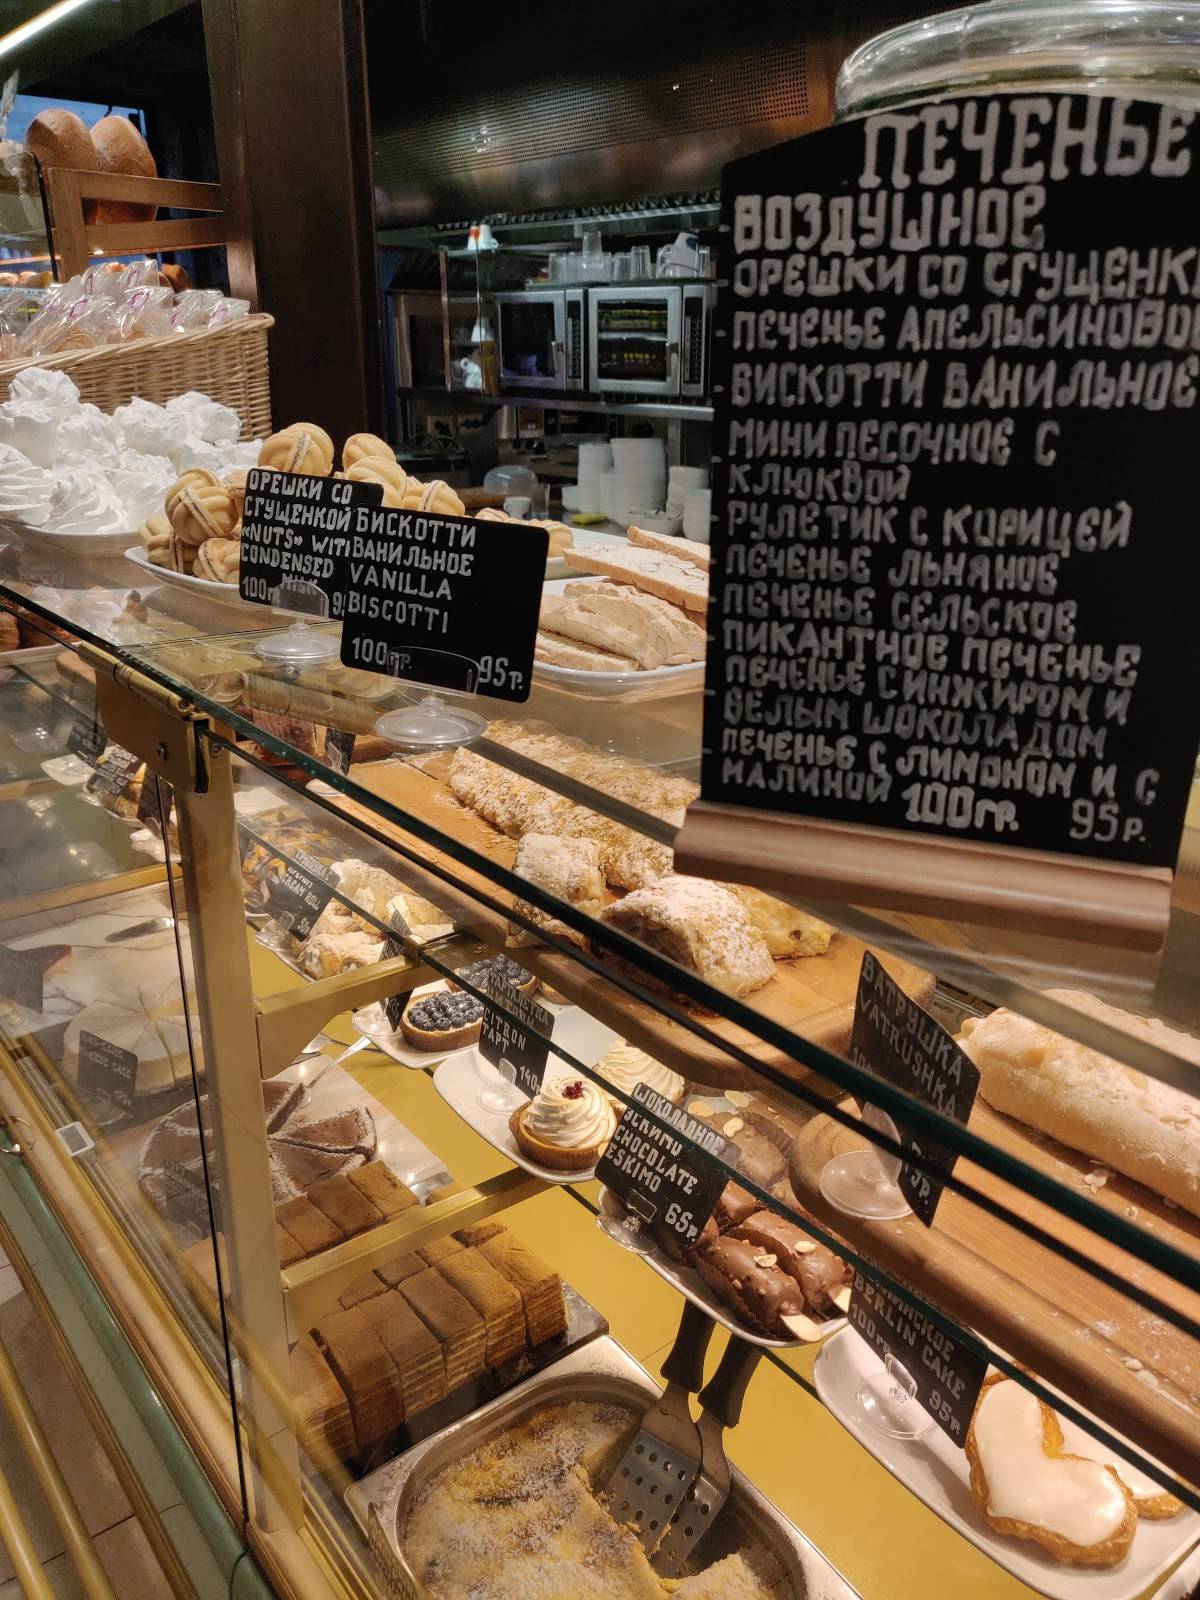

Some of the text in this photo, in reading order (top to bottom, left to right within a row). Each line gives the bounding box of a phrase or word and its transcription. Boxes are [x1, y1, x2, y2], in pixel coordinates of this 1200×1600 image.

[858, 97, 1195, 189] ПЕЧЕНЬЕ
[733, 185, 1046, 255] ВОЗДУШНОЕ
[733, 246, 1200, 304] ОРЕШКИ СО СГУЩЕНК
[732, 307, 886, 350] ПЕЧЕНЬЕ
[943, 355, 1199, 410] ВАНИЛЬНОЕ
[729, 417, 1060, 466] МИНИ ПЕСОЧНОЕ С
[249, 471, 353, 505] ОРЕШКИ СО
[727, 461, 911, 503] КЛЮКВОЙ
[244, 496, 352, 532] СГУЩЕНКОЙ
[356, 507, 477, 547] БИСКОТТИ
[727, 501, 1132, 557] РУЛЕТИК С КОРИЦЕЙ
[240, 543, 334, 579] CONDENSED
[350, 563, 452, 600] VANILLA
[352, 536, 474, 576] ВАНИЛЬНОЕ
[725, 543, 1059, 595] ПЕЧЕНЬЕ ЛЬНЯНОЕ
[348, 591, 449, 634] BISCOTTI
[723, 581, 1078, 644] ПЕЧЕНЬЕ СЕЛЬСКОЕ
[723, 619, 1141, 687] ПИКАНТНОЕ ПЕЧЕНЬЕ
[725, 655, 866, 694] ПЕЧЕНЬЕ
[1104, 687, 1132, 726] И
[722, 726, 1160, 805] ПЕЧЕНЬЕ С ЛИМОНОМ И С
[722, 756, 893, 803] МАЛИНОЙ
[484, 1007, 527, 1051] CITRON
[861, 954, 963, 1085] ВАТРУШКА
[605, 1142, 662, 1193] ESKIMO
[614, 1125, 698, 1195] CHOCOLATE
[854, 1271, 917, 1347] BERLIN
[921, 1345, 966, 1401] CAKE
